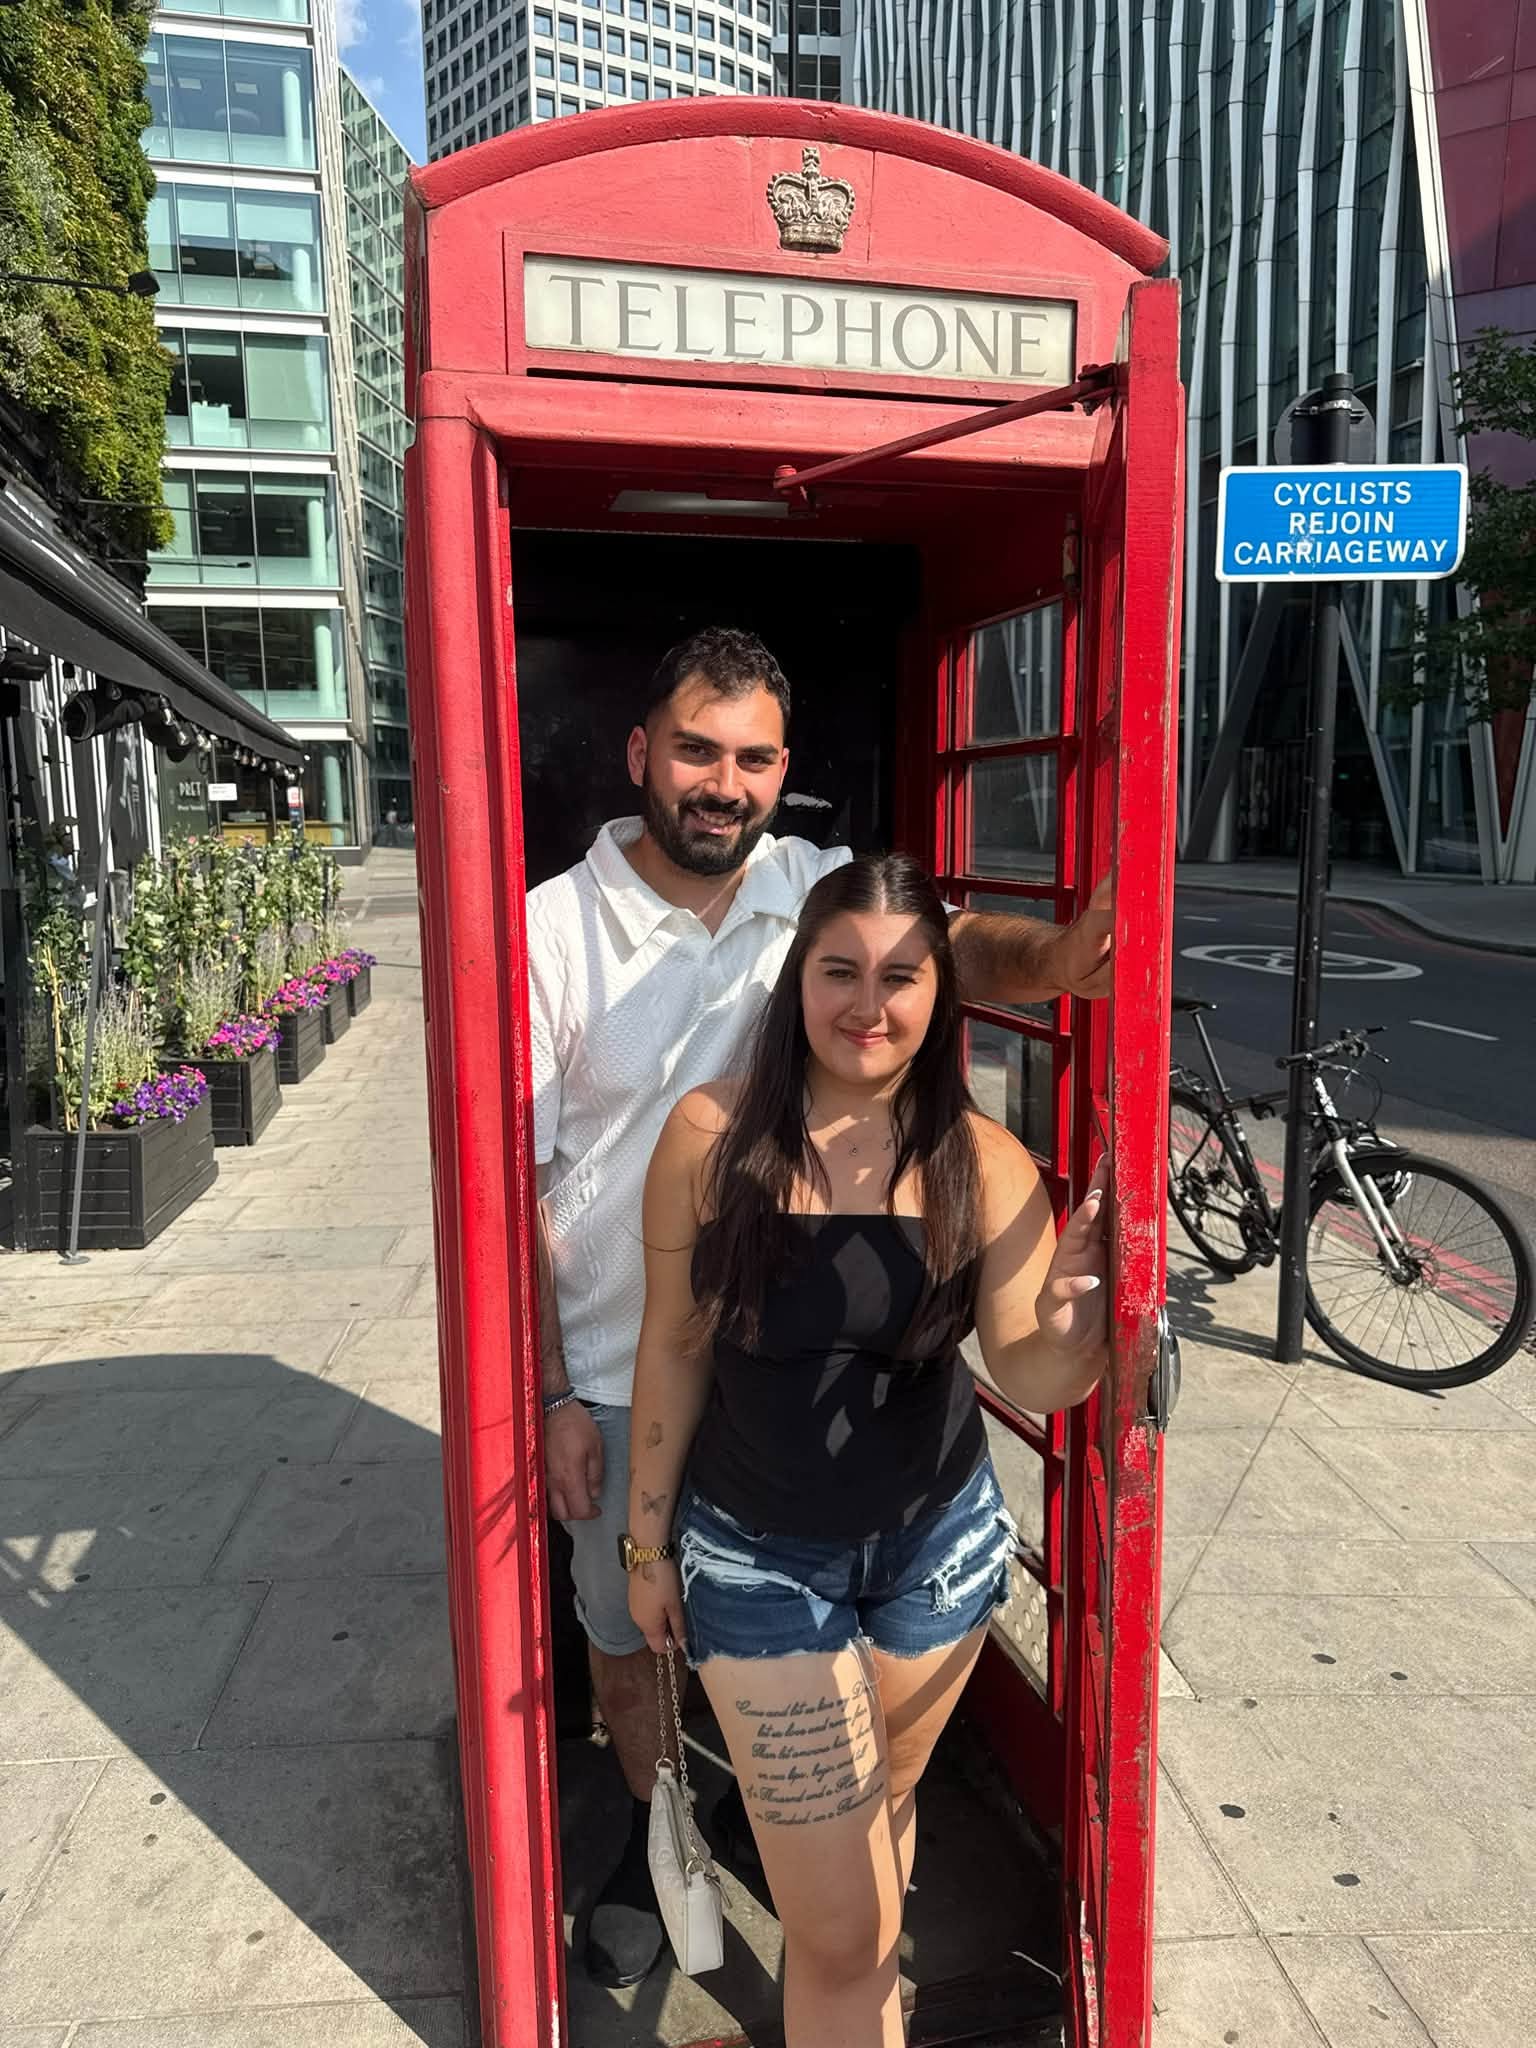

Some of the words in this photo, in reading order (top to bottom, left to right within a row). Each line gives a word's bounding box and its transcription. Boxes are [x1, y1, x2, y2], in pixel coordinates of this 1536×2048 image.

[549, 274, 1049, 377] TELEPHONE
[1274, 481, 1412, 506] CYCLISTS
[1289, 511, 1394, 535] REJOIN
[1234, 539, 1448, 566] CARRIAGEWAY
